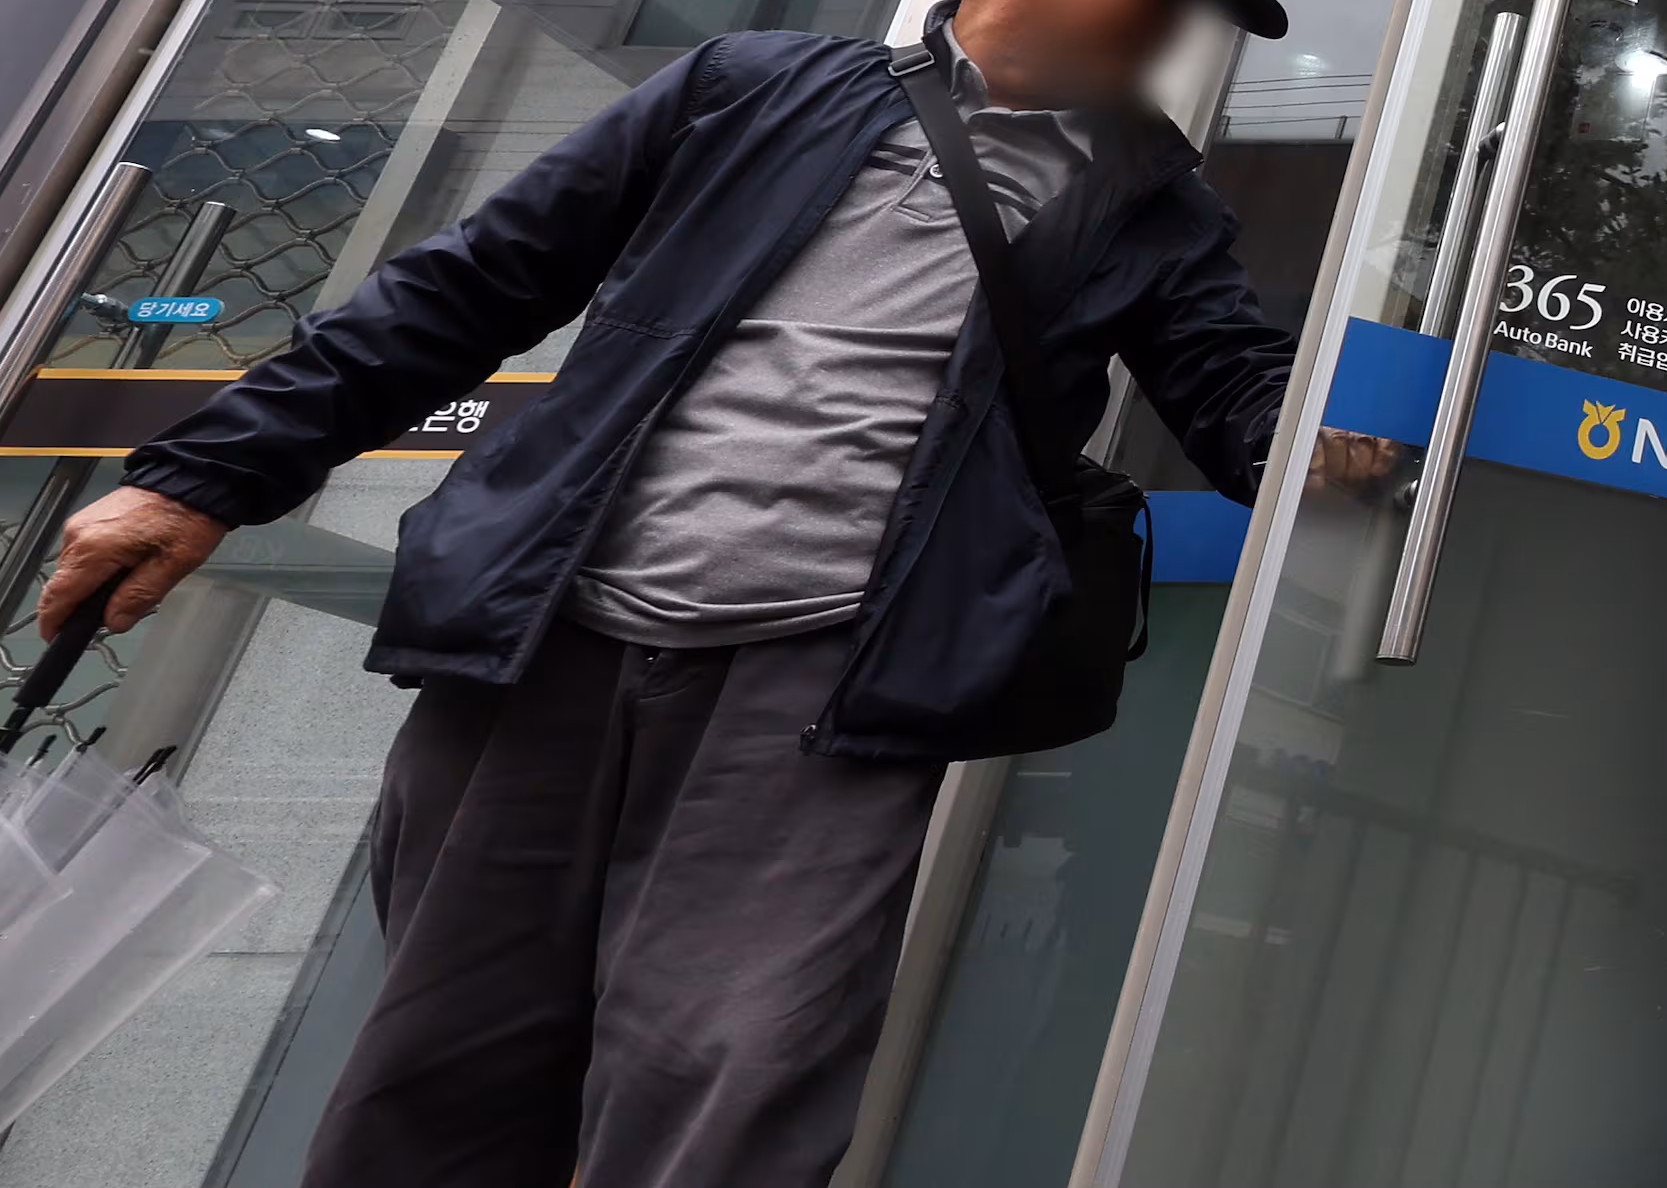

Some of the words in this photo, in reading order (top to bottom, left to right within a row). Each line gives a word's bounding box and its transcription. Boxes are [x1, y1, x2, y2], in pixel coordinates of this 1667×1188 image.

[137, 301, 210, 318] 당기세요
[1498, 264, 1607, 331] 365
[1493, 320, 1543, 346] Auto
[1544, 331, 1594, 359] Bank
[408, 399, 490, 433] 은행
